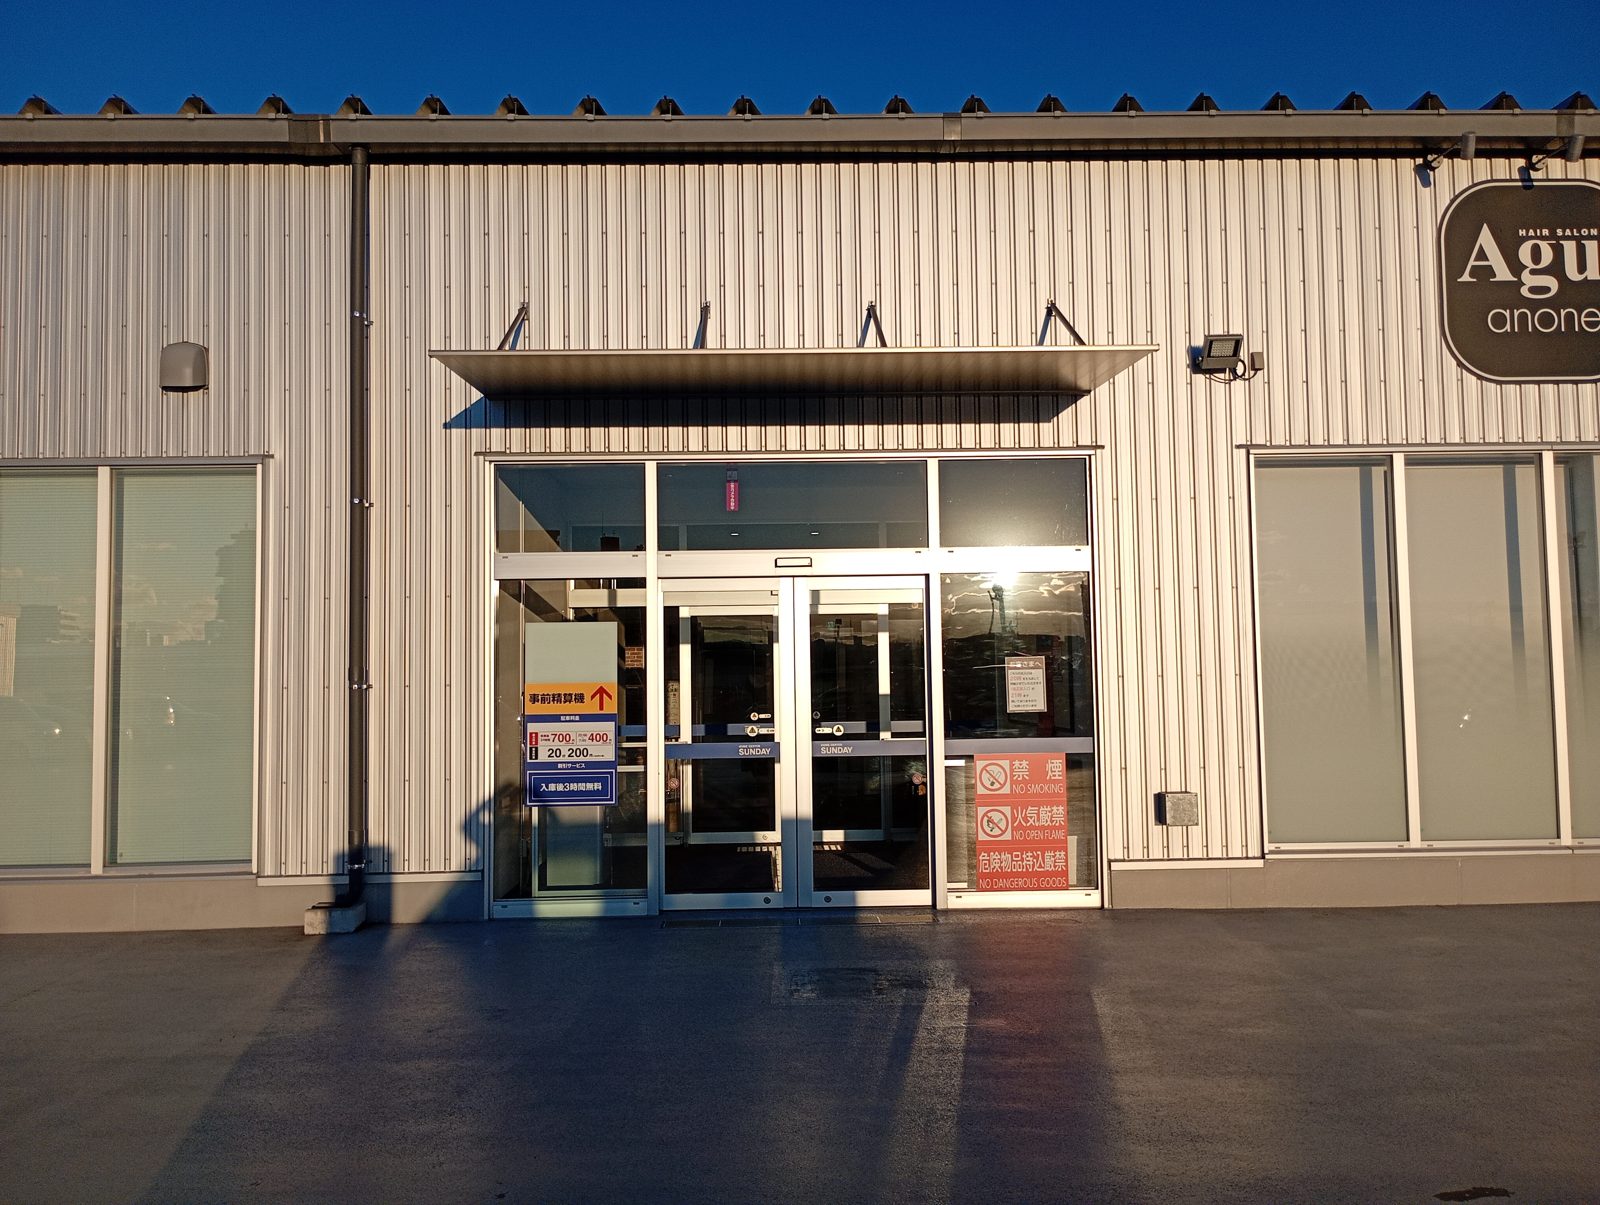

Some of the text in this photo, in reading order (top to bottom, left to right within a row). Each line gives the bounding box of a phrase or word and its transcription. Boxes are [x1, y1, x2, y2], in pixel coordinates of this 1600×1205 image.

[1518, 228, 1598, 237] HAIR SALON
[1457, 222, 1600, 299] Agu
[1487, 308, 1600, 332] anone
[528, 693, 585, 705] 事前精算機
[738, 748, 771, 756] SUNDAY
[820, 746, 853, 754] SUNDAY
[539, 783, 602, 792] 入庫後3時間無料
[1012, 783, 1064, 794] NO SMOKING
[1013, 805, 1065, 827] 火気厳禁
[1013, 829, 1066, 841] NO OPEN FLAME
[979, 850, 1067, 873] 危険物品持込厳禁
[979, 877, 1067, 889] NO DANGEROUS GOODS
